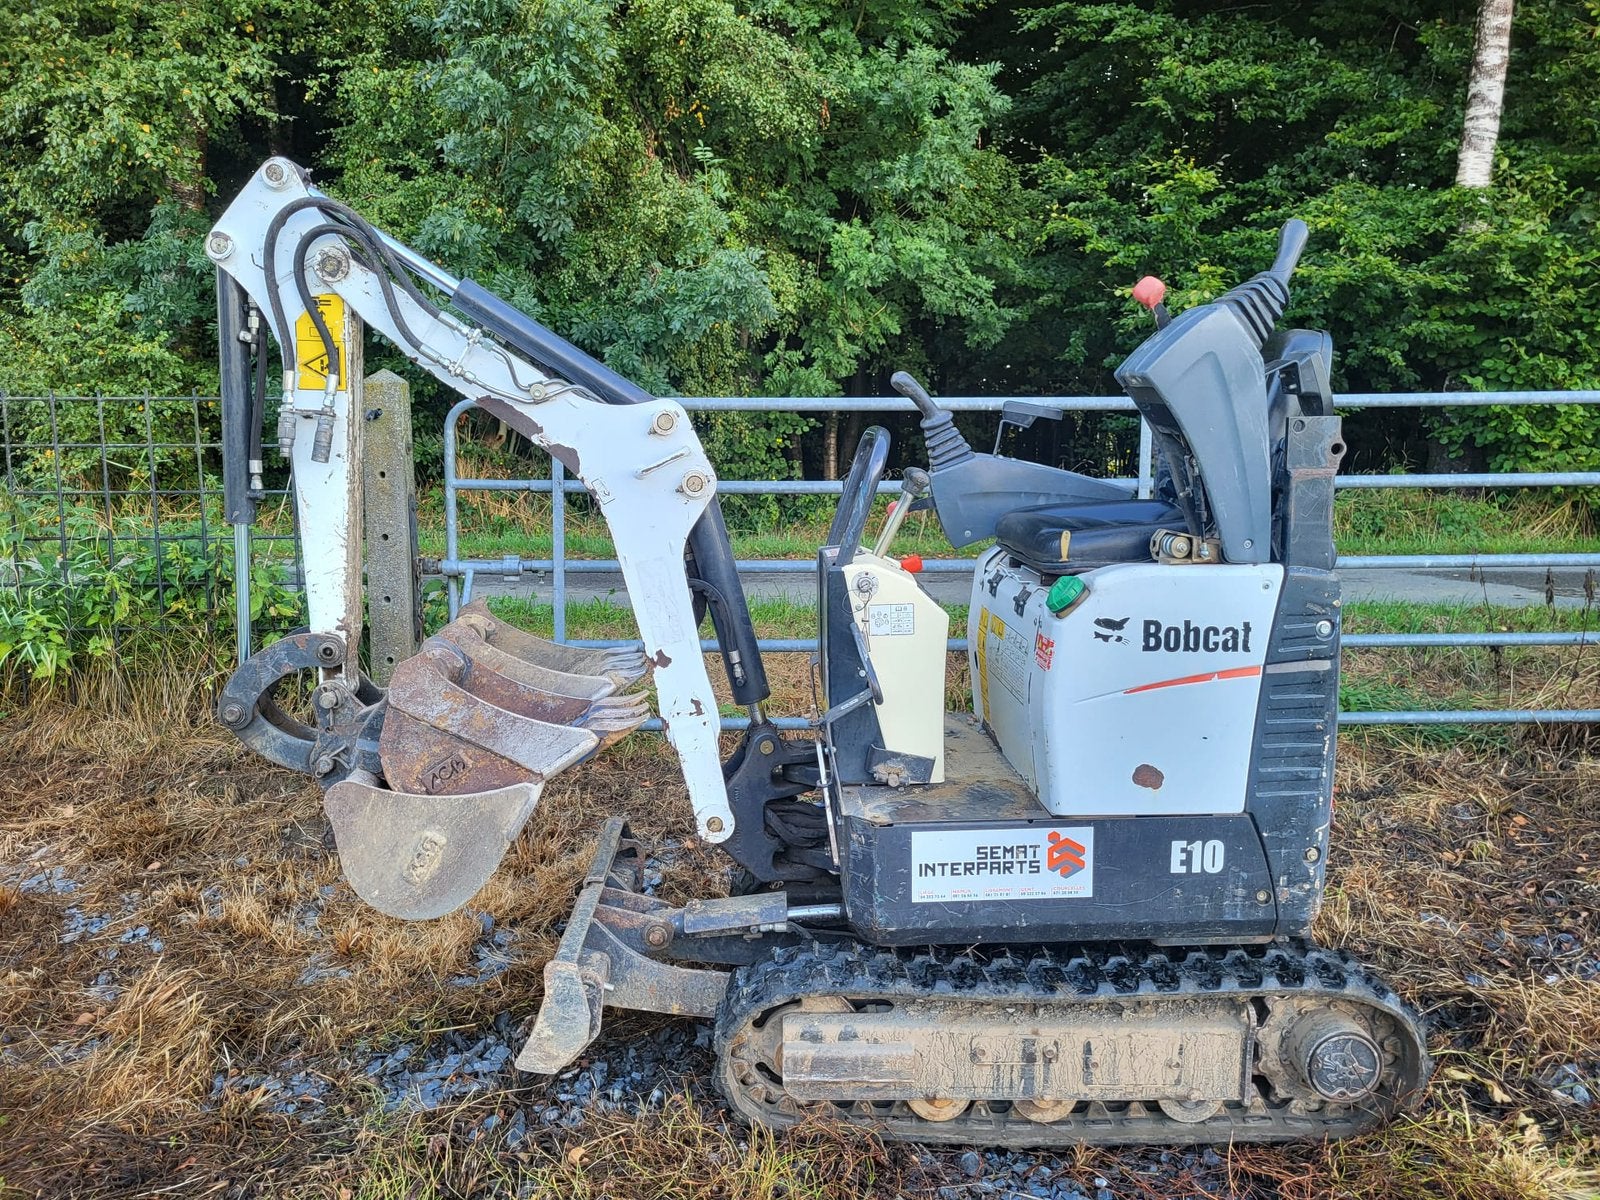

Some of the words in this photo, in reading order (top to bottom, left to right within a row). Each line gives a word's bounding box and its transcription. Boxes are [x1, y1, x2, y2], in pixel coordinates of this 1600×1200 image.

[1142, 619, 1252, 653] Bobcat
[976, 844, 1041, 860] SEMAT
[1170, 839, 1225, 874] E10
[918, 860, 1041, 877] INTERPARTS
